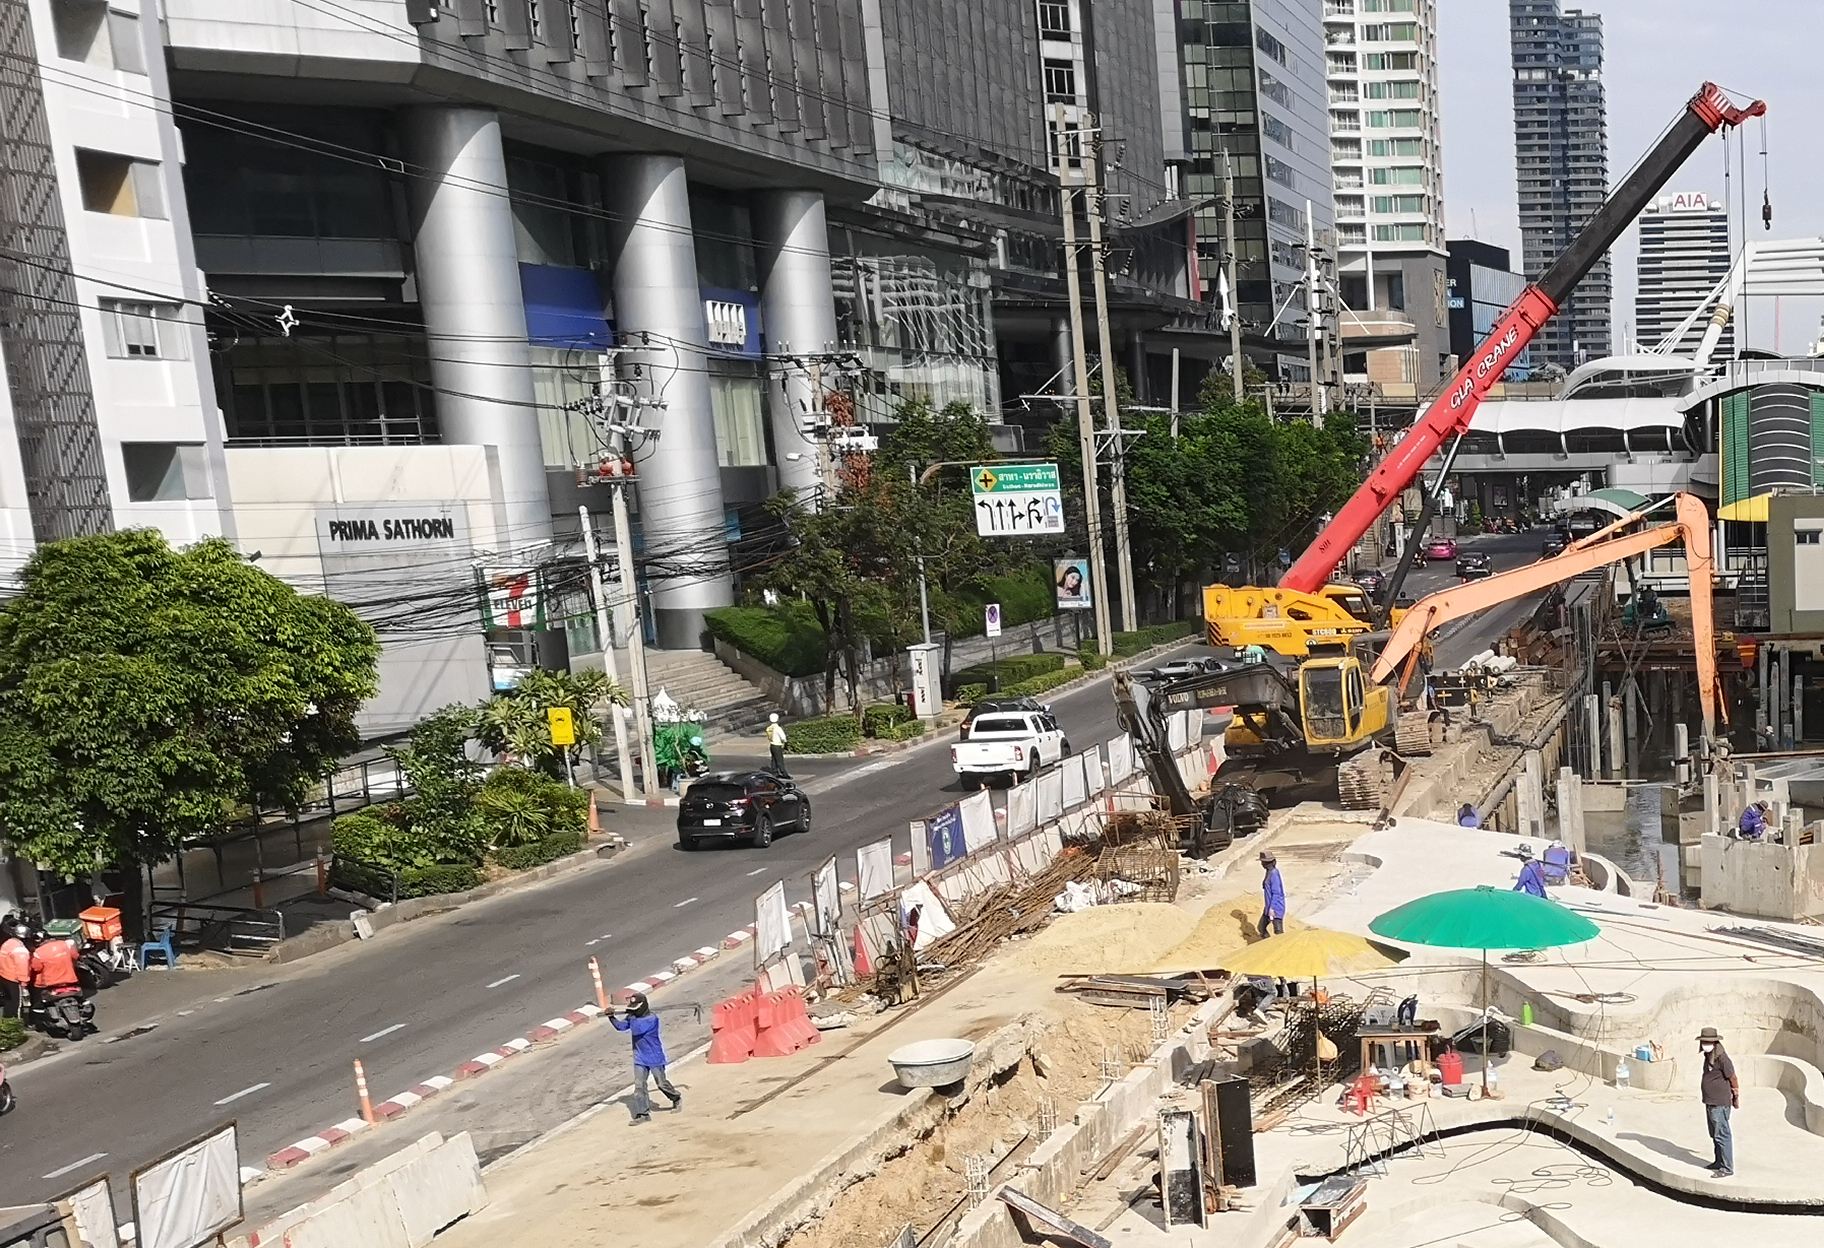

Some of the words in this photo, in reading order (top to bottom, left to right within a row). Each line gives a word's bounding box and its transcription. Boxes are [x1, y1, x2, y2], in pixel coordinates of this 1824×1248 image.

[1674, 194, 1706, 208] AIA
[1450, 376, 1475, 410] GLA
[1476, 327, 1520, 379] CRANE
[329, 520, 379, 542] PRIMA
[384, 518, 455, 540] SATHORN
[1168, 692, 1189, 705] VOLVO
